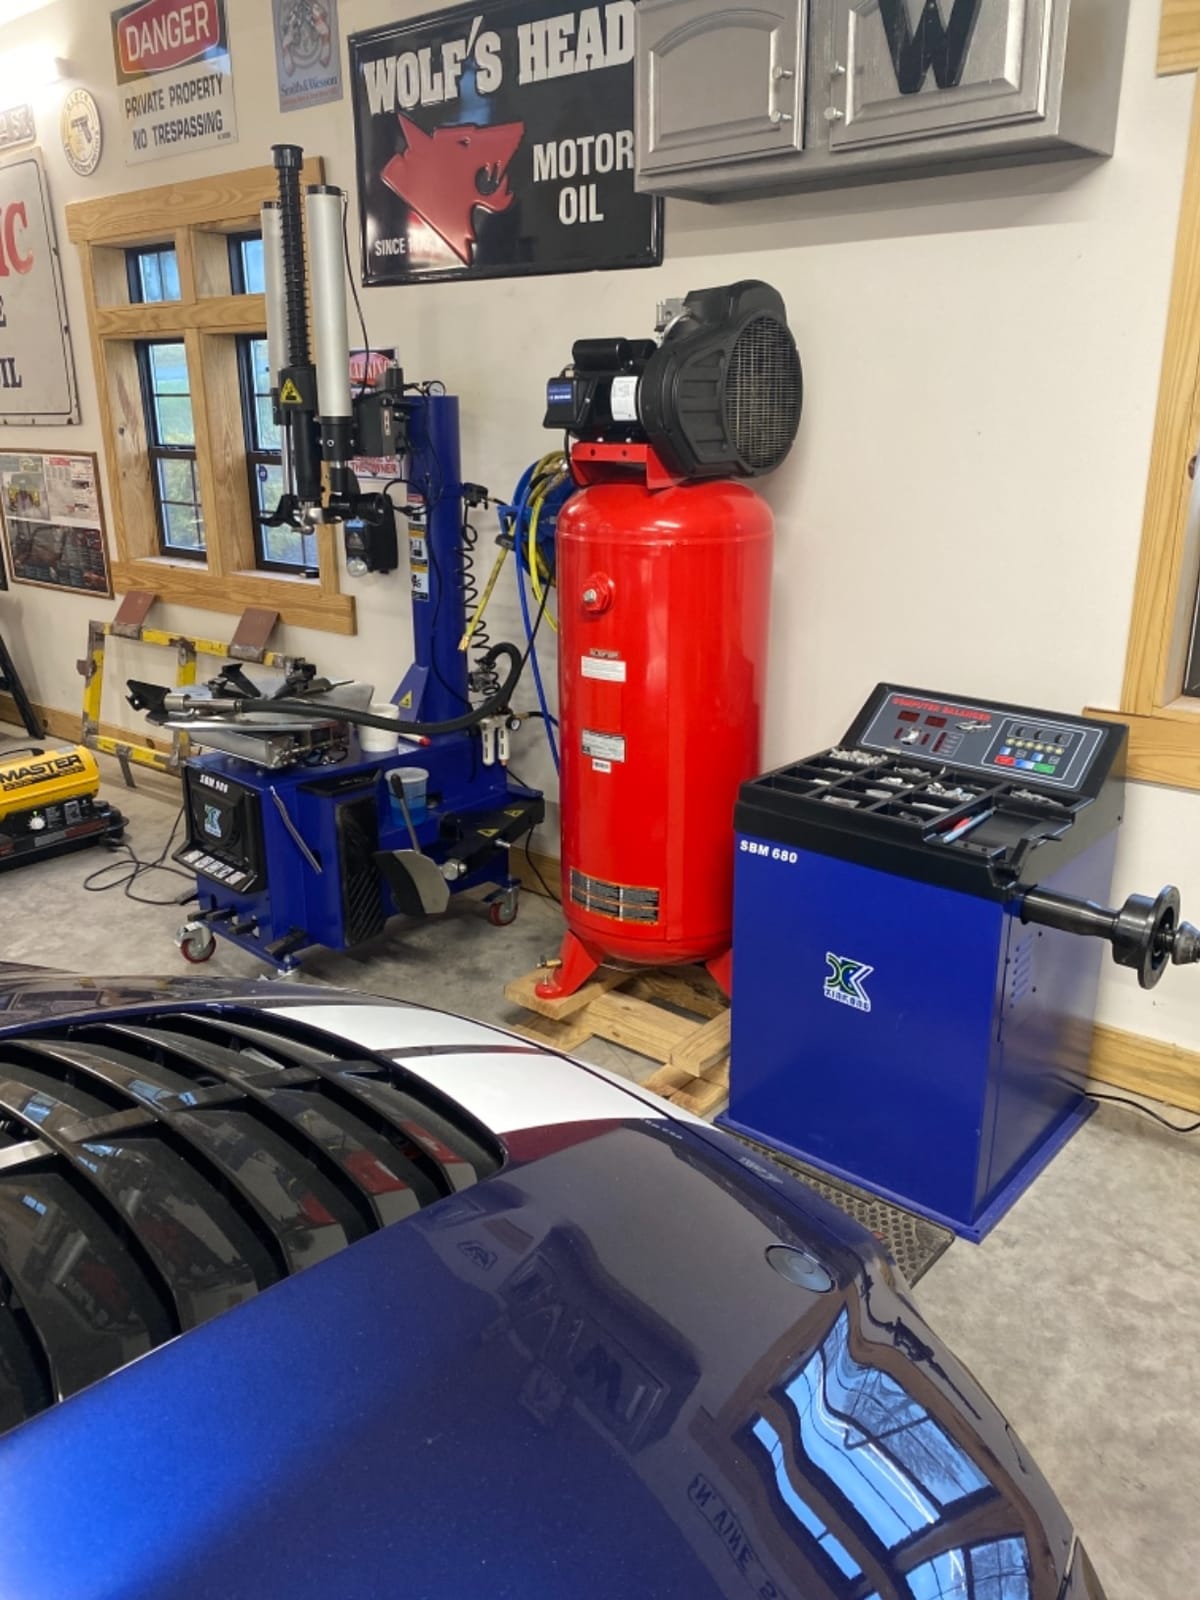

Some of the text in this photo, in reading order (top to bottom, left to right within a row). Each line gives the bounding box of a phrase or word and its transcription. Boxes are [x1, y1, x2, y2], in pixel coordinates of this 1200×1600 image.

[126, 1, 210, 62] DANGER
[878, 0, 981, 94] W
[363, 1, 635, 117] WOLF'S HEAD
[125, 72, 223, 119] PRIVATE PROPERTY
[133, 109, 223, 150] NO TRESPASSING
[533, 130, 634, 182] MOTOR
[558, 183, 604, 225] OIL
[375, 238, 406, 256] SINCE
[0, 754, 82, 783] MASTER
[740, 840, 798, 864] SBM 680
